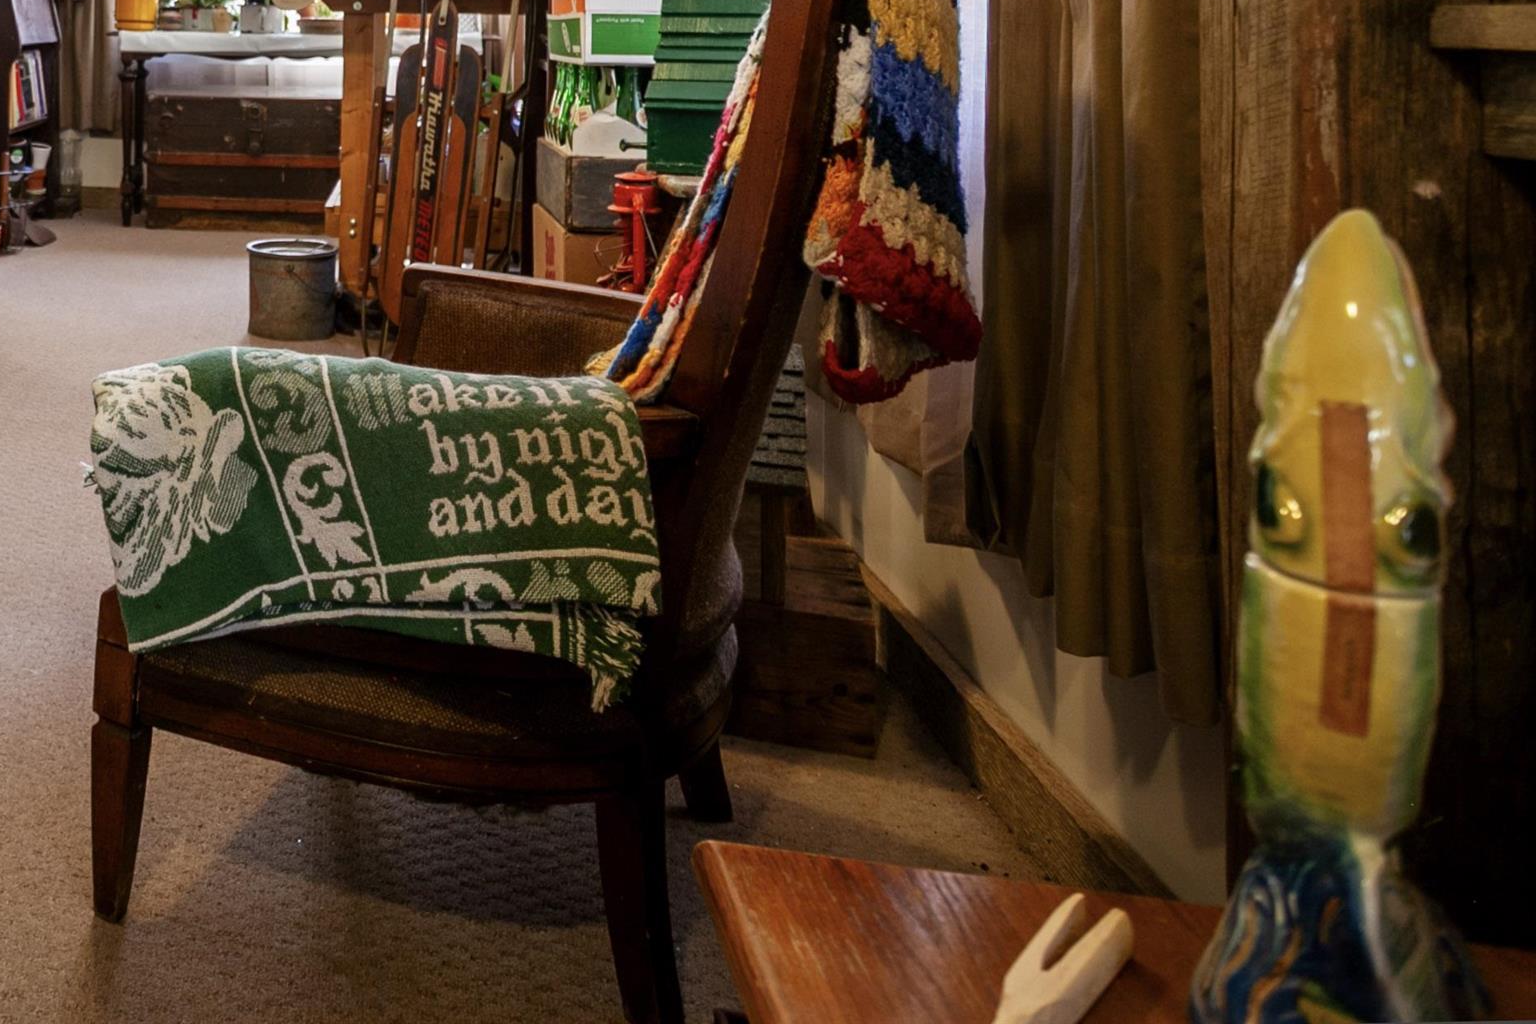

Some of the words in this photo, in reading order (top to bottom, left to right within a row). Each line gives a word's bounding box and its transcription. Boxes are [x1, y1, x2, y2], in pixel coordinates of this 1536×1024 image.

[420, 91, 443, 191] Hiawatha
[344, 371, 523, 430] Make
[418, 419, 503, 485] by
[428, 468, 538, 538] and
[546, 465, 657, 547] day
